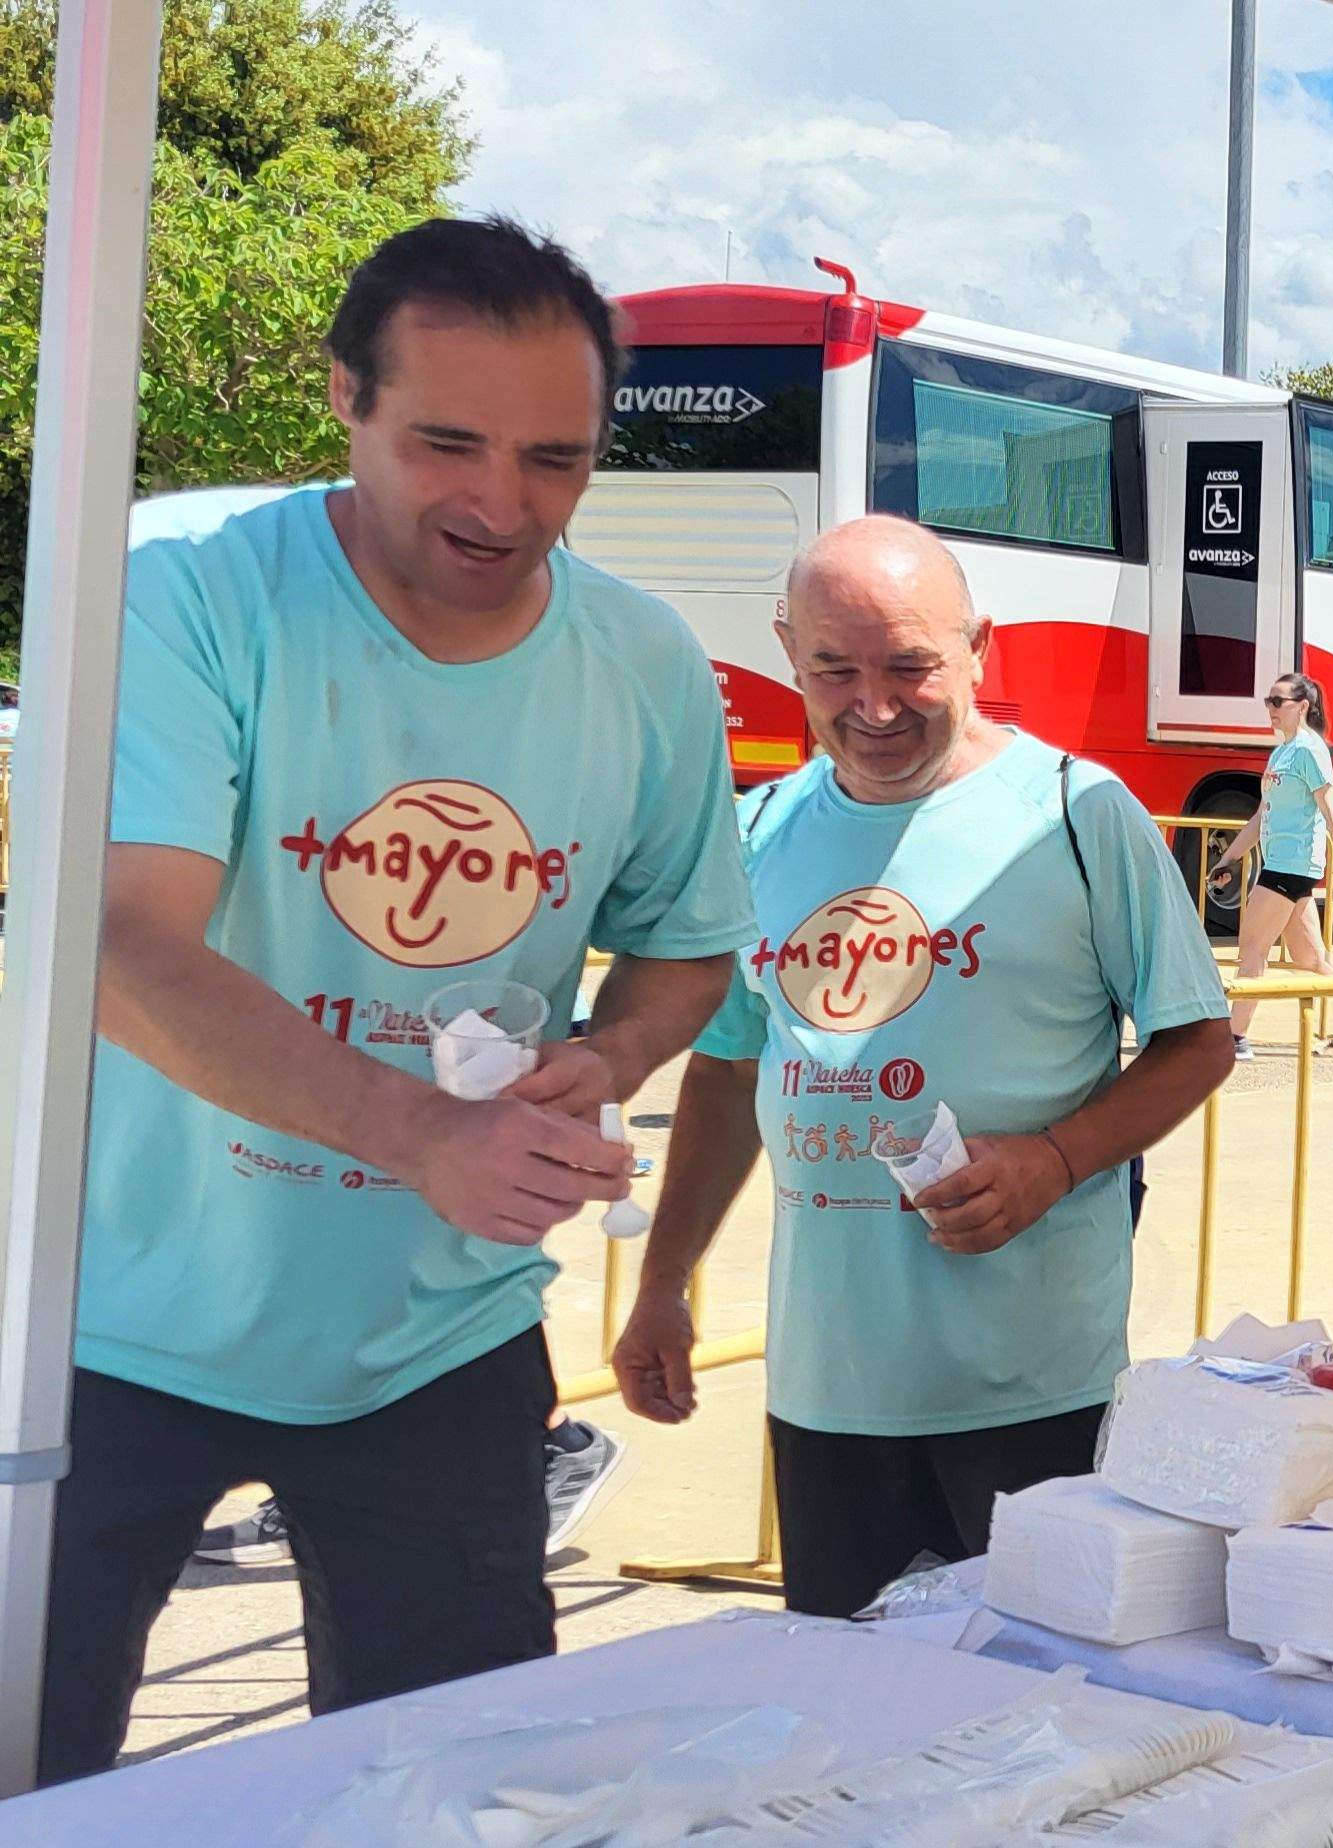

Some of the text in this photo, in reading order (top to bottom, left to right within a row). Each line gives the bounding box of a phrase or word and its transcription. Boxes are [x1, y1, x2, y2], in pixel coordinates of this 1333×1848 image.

[613, 385, 735, 412] avanza
[1206, 470, 1239, 481] ACCESO
[1188, 549, 1240, 562] avanza
[751, 922, 986, 997] +mayores
